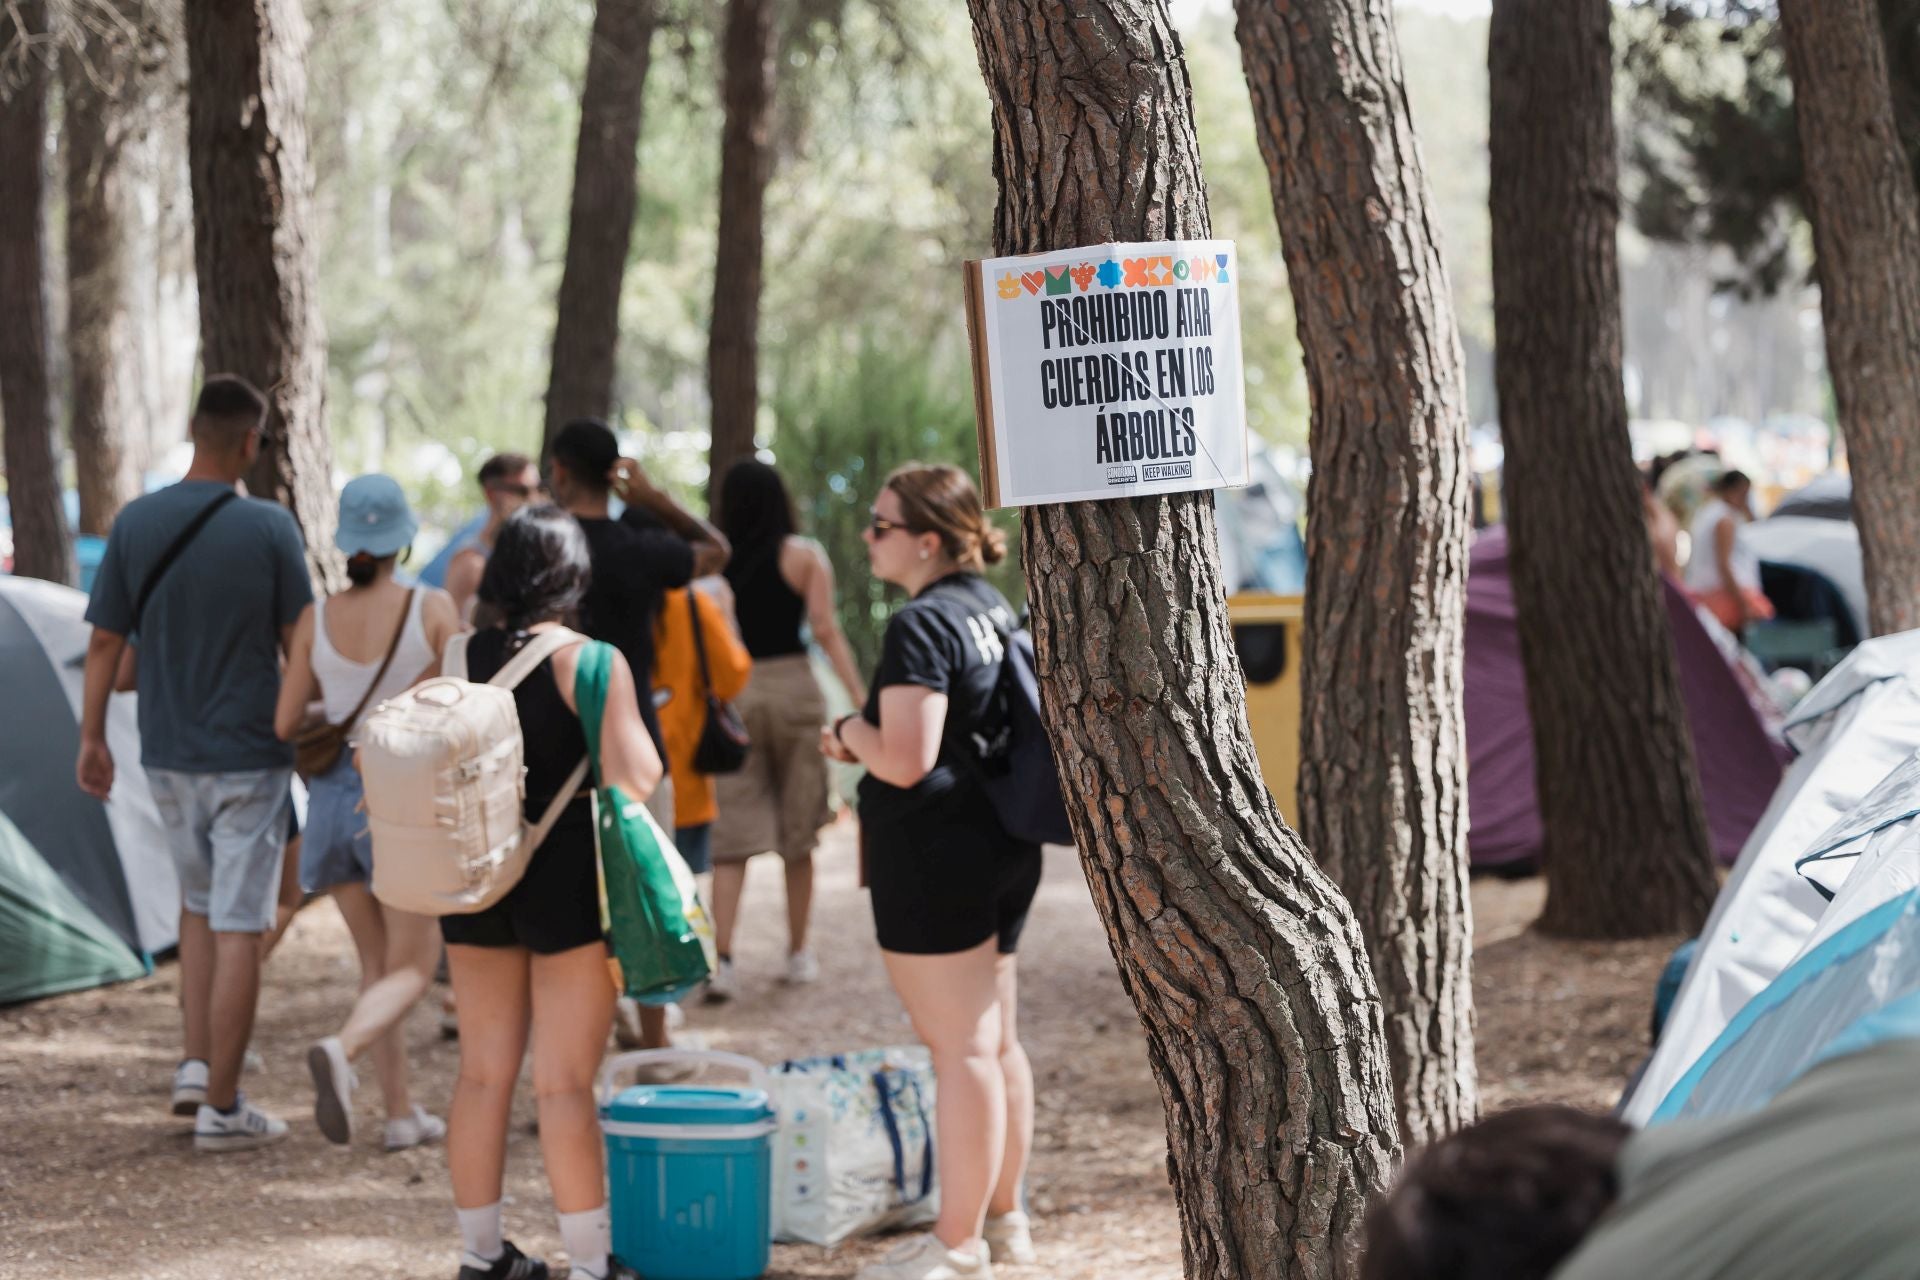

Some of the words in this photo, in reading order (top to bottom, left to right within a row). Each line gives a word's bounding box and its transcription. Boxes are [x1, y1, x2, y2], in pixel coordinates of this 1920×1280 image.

[1040, 289, 1169, 349] PROHIBIDO
[1176, 287, 1212, 338] ATAR
[1040, 351, 1151, 410] CUERDAS
[1155, 348, 1187, 399] EN
[1189, 346, 1215, 397] LOS
[1096, 405, 1197, 464] ÁRBOLES
[1144, 466, 1161, 479] KEEP
[1160, 464, 1190, 478] WALKING
